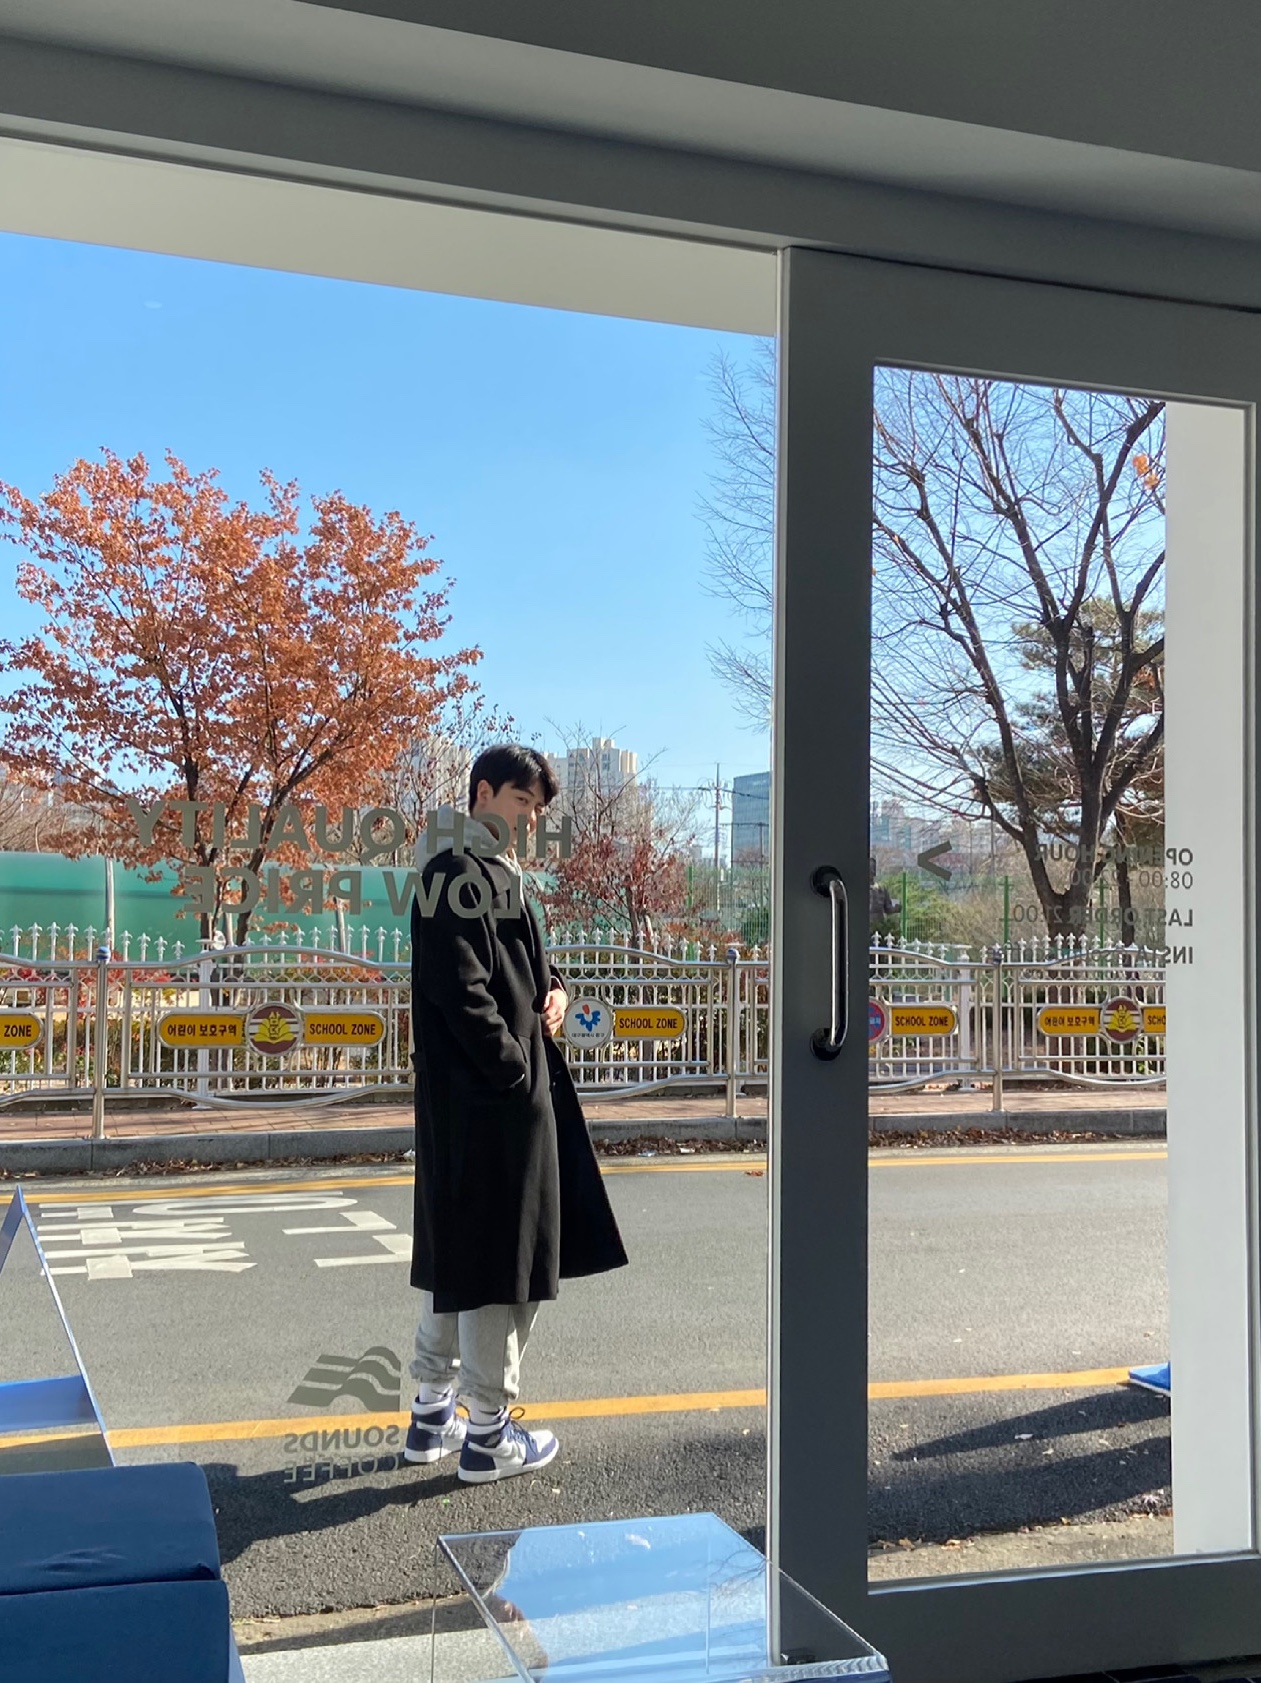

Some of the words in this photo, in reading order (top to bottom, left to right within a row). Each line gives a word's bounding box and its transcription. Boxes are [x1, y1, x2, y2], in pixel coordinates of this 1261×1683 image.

[619, 1018, 653, 1029] SCHOOL
[655, 1017, 678, 1029] ZONE
[895, 1015, 925, 1027] SCHOOL
[929, 1015, 948, 1026] ZONE
[1044, 1016, 1065, 1027] 어린이
[1067, 1015, 1095, 1026] 보호구역
[4, 1024, 32, 1037] ZONE
[167, 1023, 196, 1037] 어린이
[199, 1023, 237, 1037] 보호구역
[309, 1023, 348, 1036] SCHOOL
[351, 1023, 376, 1036] ZONE
